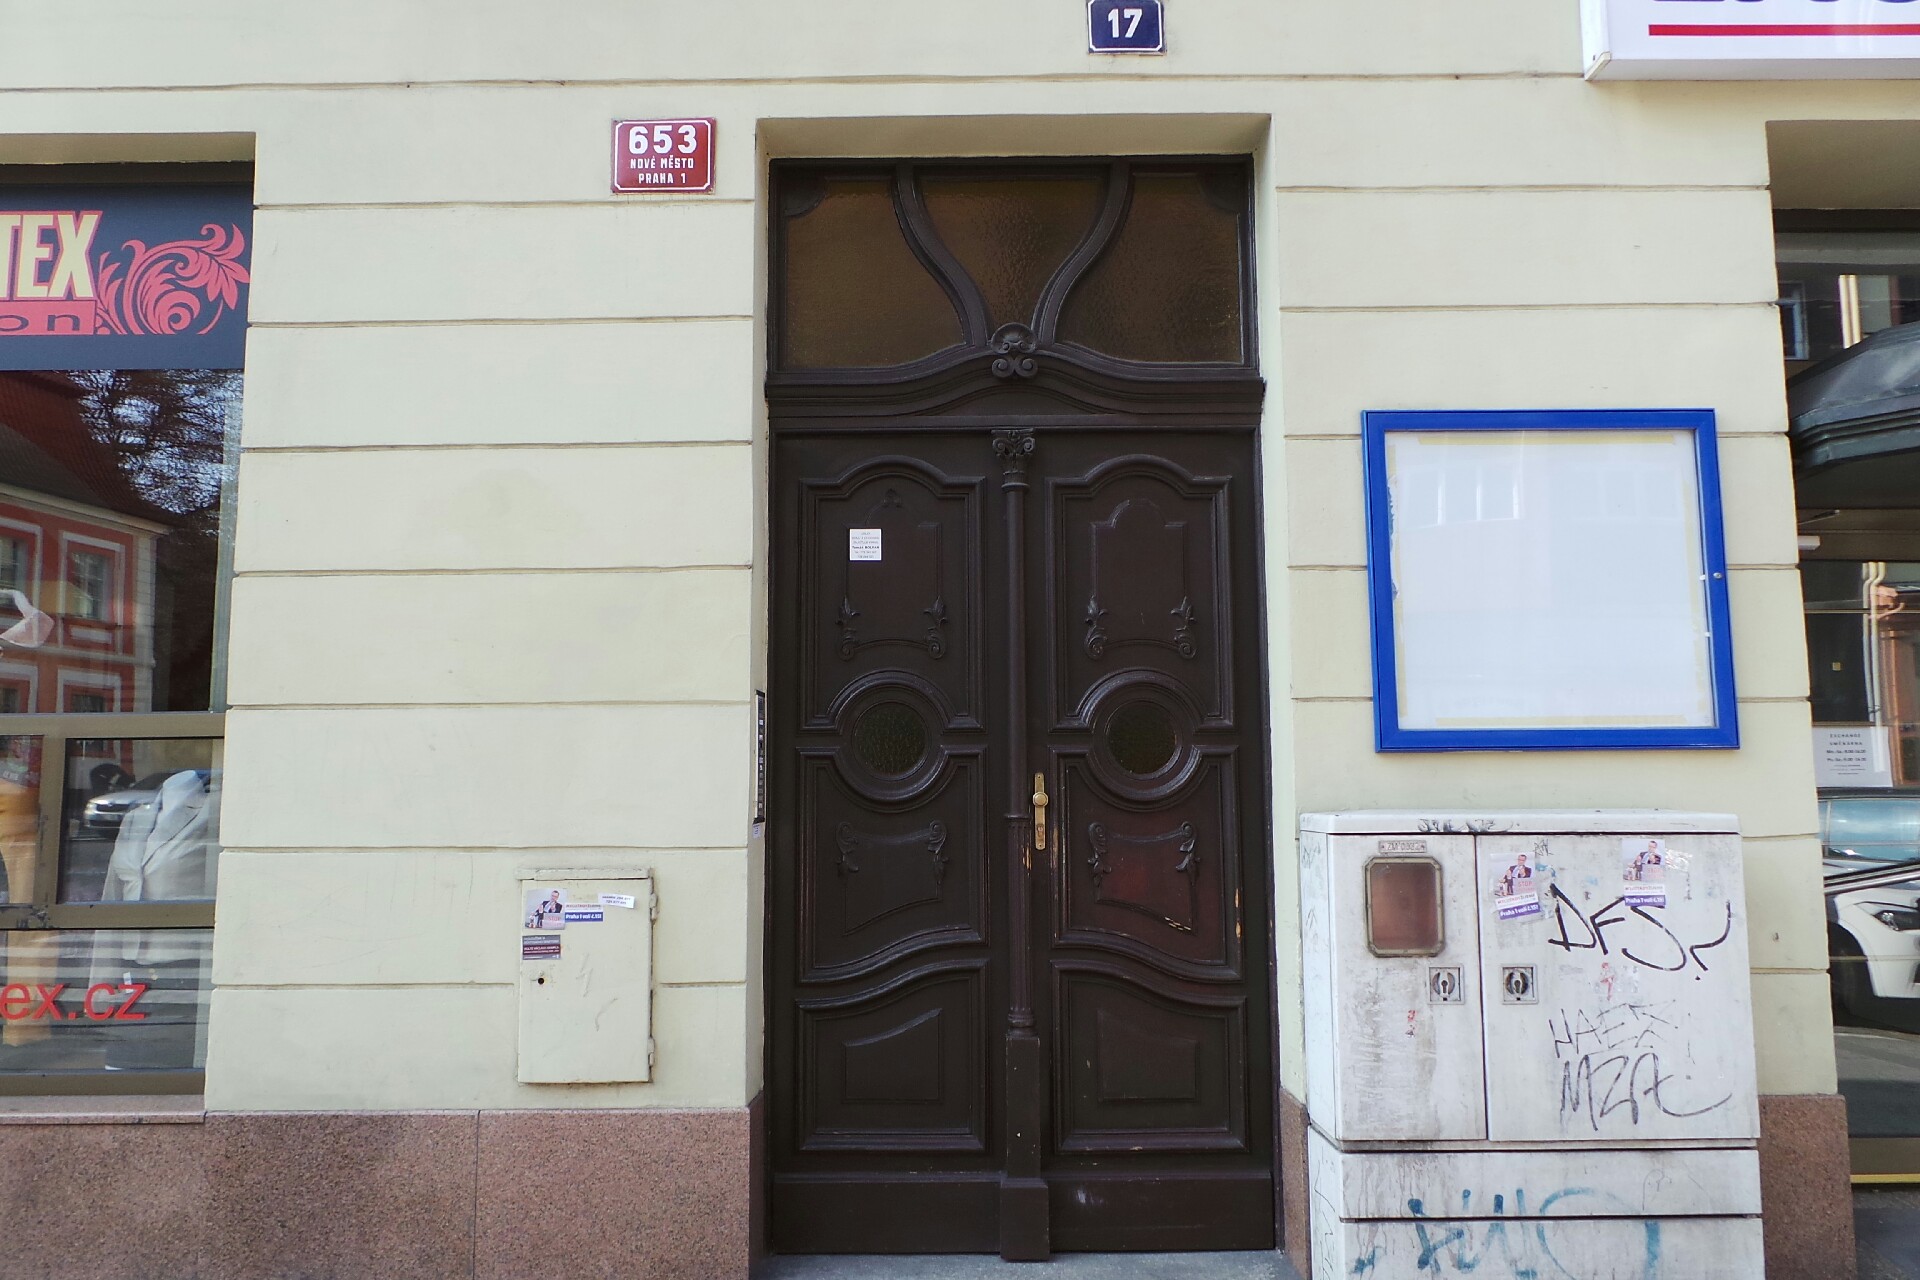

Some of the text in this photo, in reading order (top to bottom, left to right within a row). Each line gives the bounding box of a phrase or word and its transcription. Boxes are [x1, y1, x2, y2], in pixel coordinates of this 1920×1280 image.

[1107, 8, 1143, 38] 17
[628, 124, 697, 155] 653
[630, 154, 694, 169] NOVÉ MĚSTO
[638, 172, 686, 184] PRAHA 1
[0, 983, 146, 1020] ex.cz
